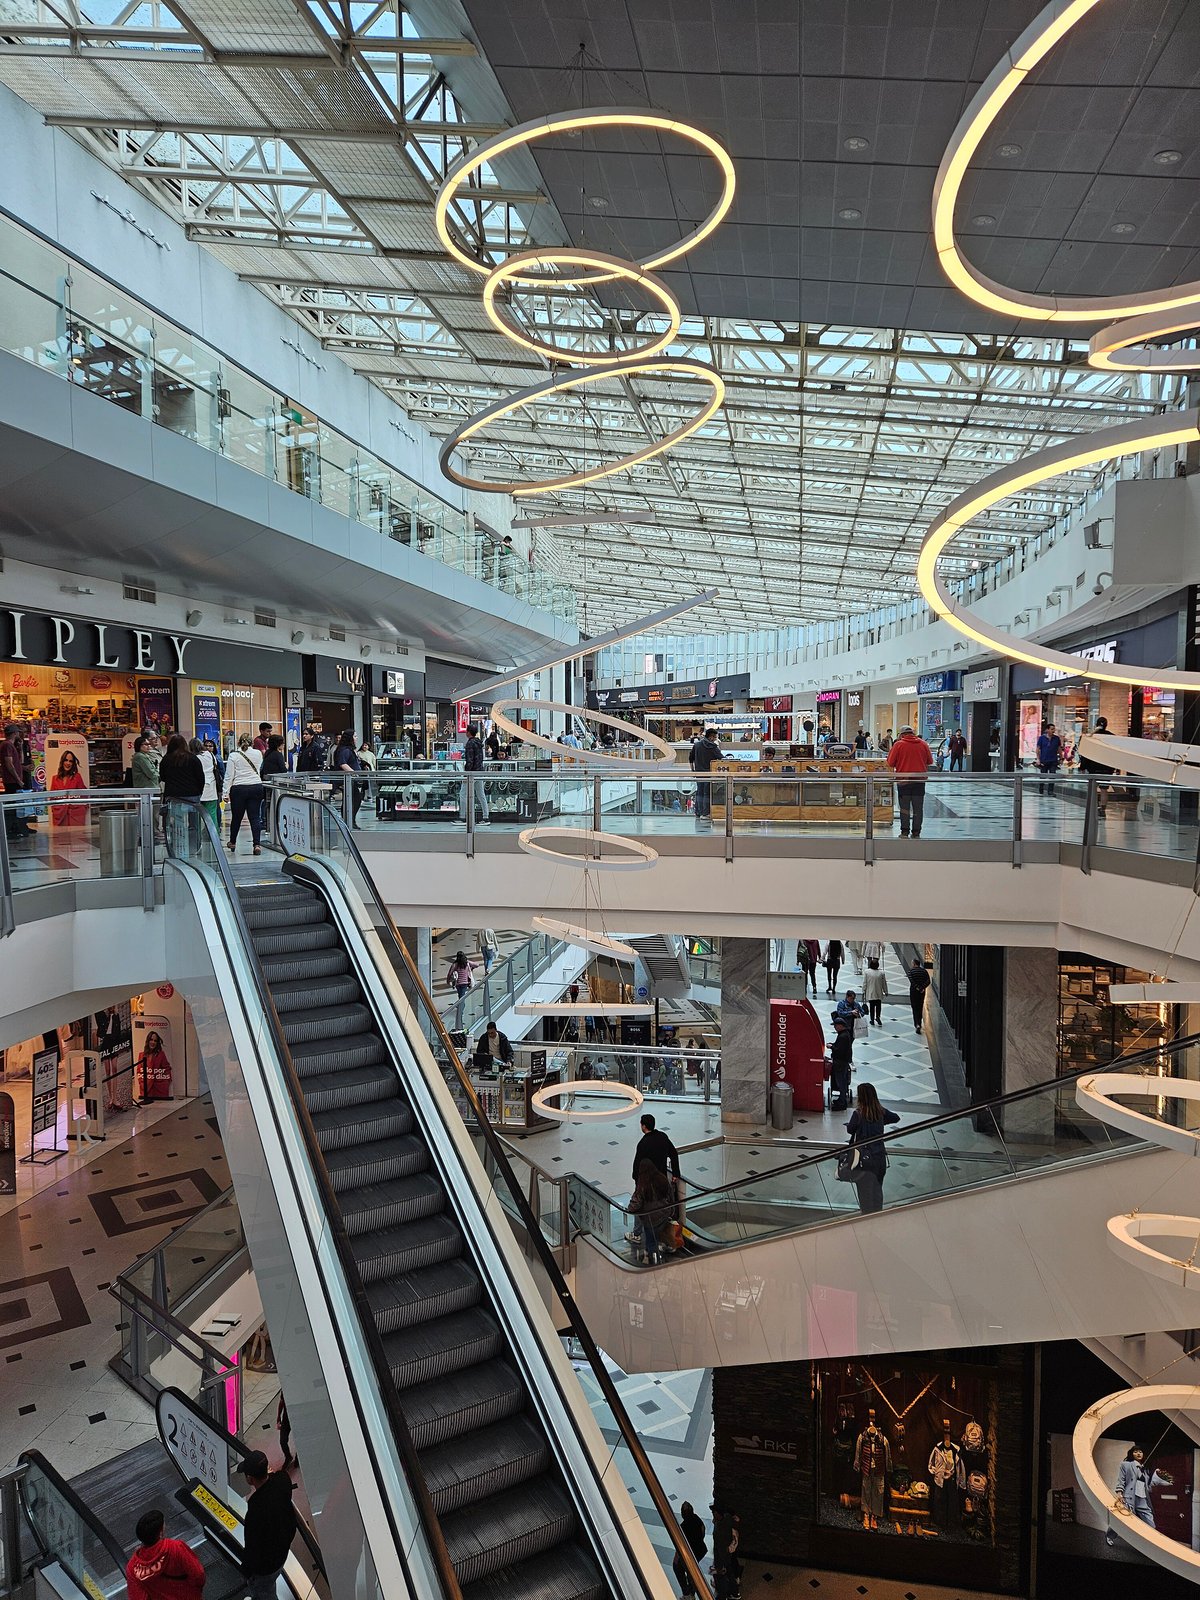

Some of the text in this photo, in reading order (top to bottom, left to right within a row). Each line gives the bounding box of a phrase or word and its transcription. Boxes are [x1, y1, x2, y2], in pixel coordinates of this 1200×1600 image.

[12, 673, 39, 688] Barbie
[518, 800, 532, 817] JL
[282, 815, 288, 839] 3
[111, 1040, 131, 1054] JEANS
[777, 1012, 787, 1065] Santander
[167, 1413, 179, 1448] 2
[764, 1439, 797, 1452] RKF
